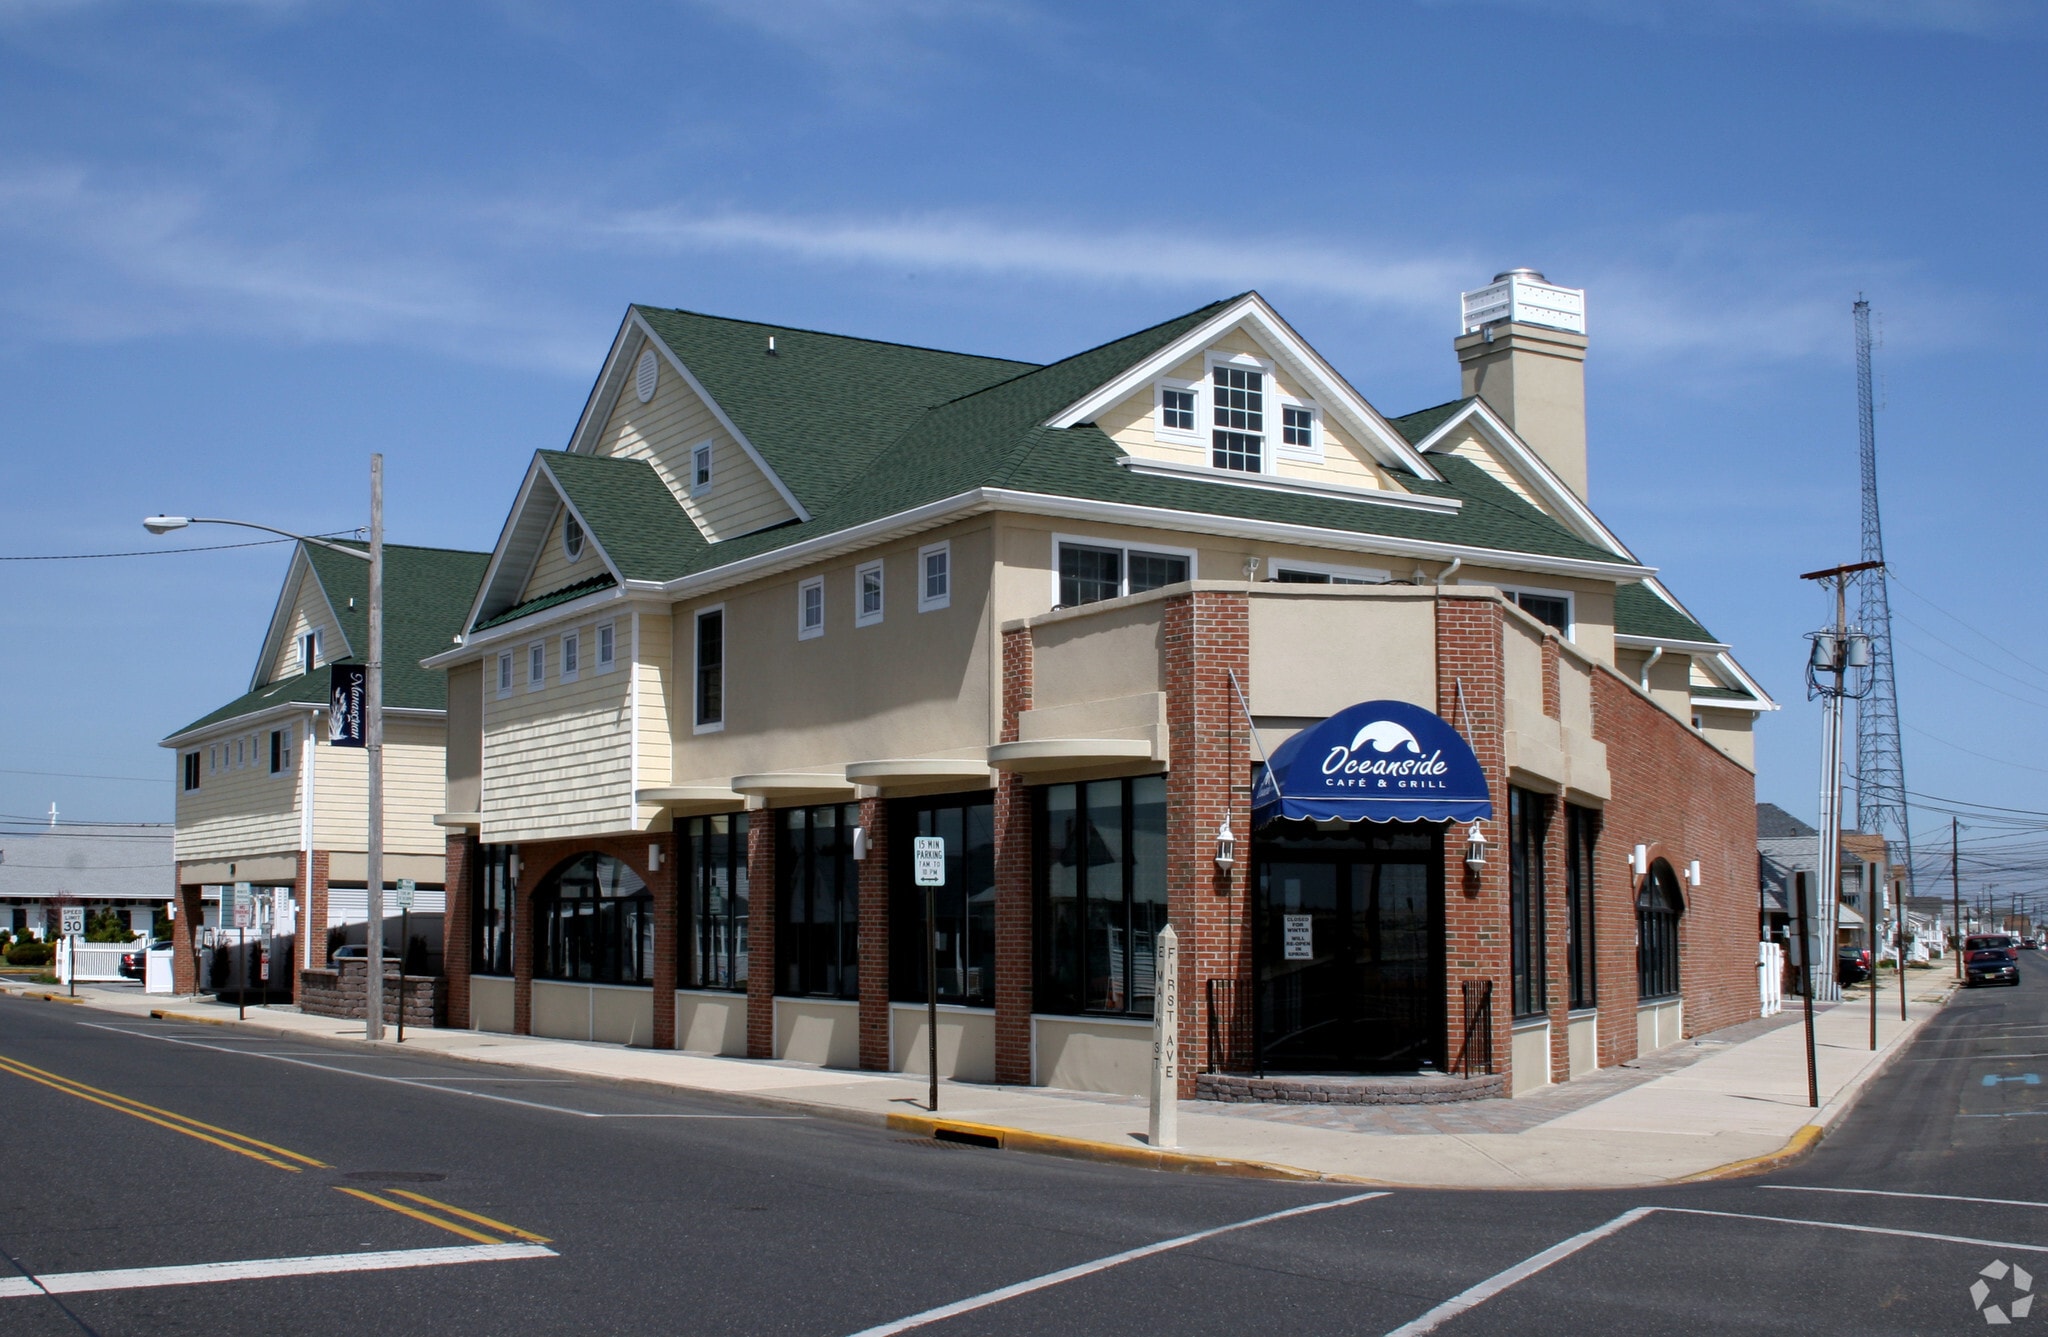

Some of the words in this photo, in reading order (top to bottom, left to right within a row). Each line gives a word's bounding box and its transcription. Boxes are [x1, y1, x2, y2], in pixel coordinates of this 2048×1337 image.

[1322, 746, 1447, 776] Oceanside
[1326, 777, 1366, 787] CAFÉ
[1378, 779, 1387, 788] &
[1398, 780, 1446, 788] GRILL
[919, 840, 925, 849] 15
[928, 840, 939, 849] MIN
[917, 851, 942, 859] PARKING
[64, 921, 81, 931] 30
[1158, 946, 1164, 958] E
[1167, 947, 1175, 1023] FIRST
[1154, 1042, 1160, 1069] ST
[1165, 1035, 1174, 1078] AVE
